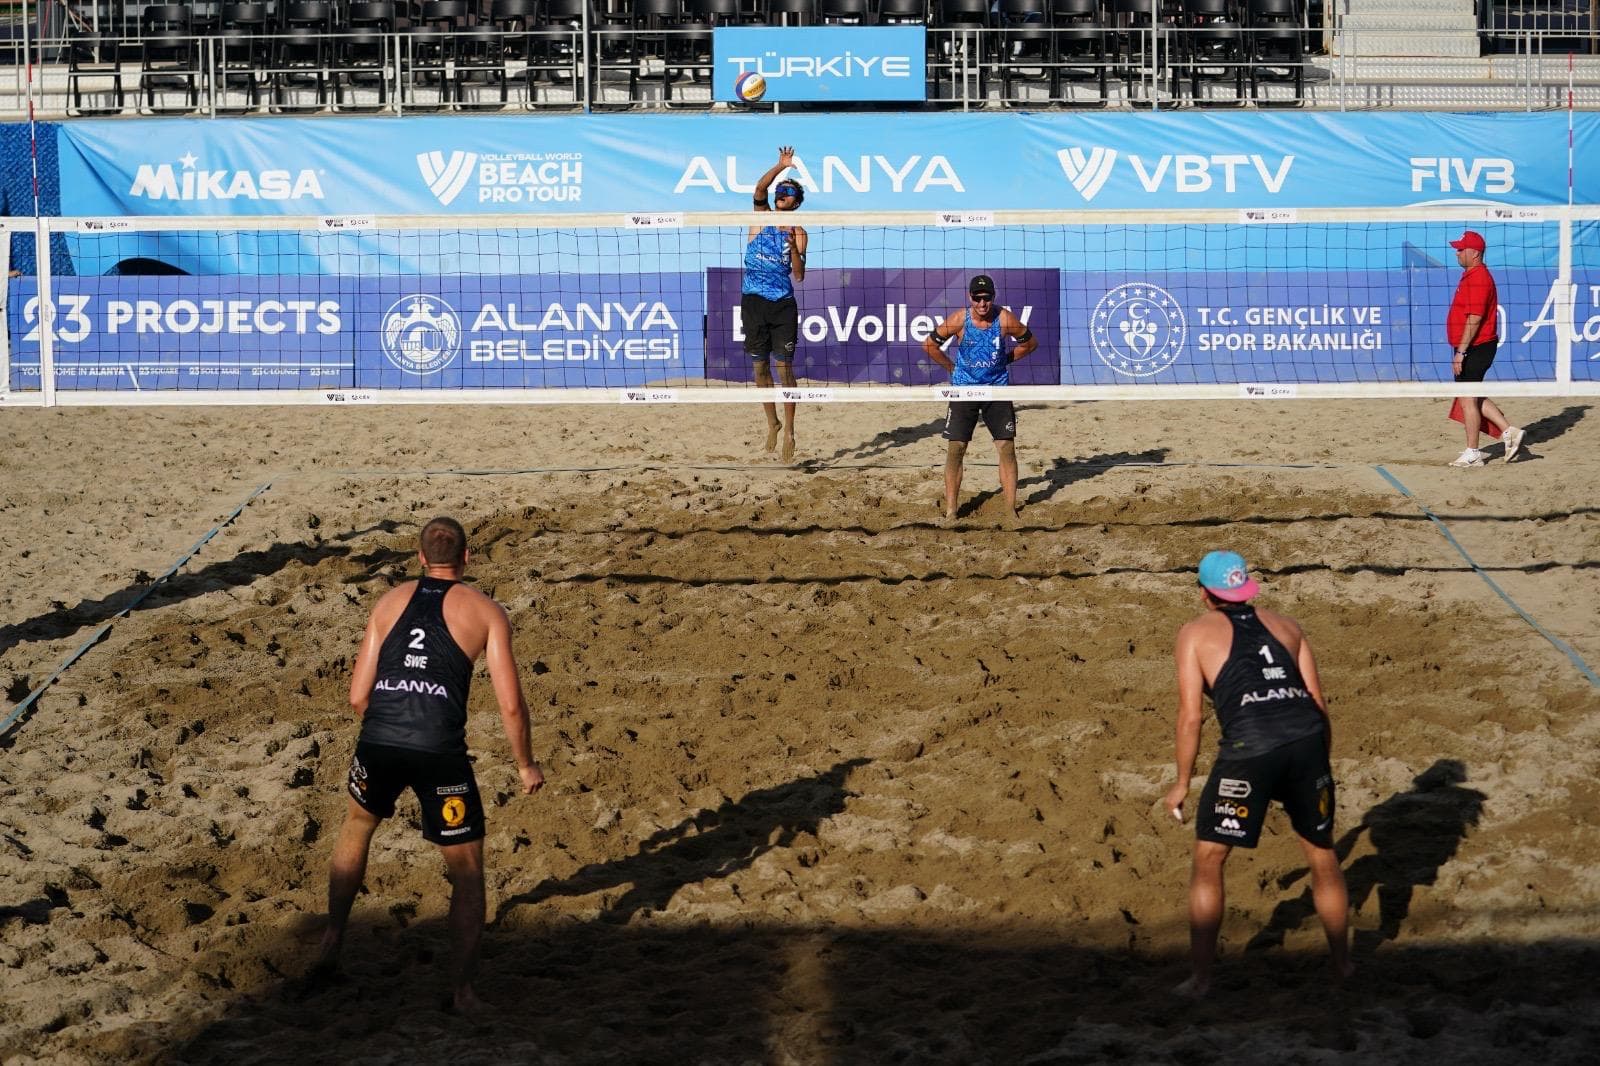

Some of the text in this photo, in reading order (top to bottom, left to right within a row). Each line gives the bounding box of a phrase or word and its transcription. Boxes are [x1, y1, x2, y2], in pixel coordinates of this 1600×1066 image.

[728, 51, 911, 77] TÜRKİYE
[480, 152, 583, 161] VOLLEYBALL WORLD
[479, 162, 583, 185] BEACH
[1128, 154, 1296, 193] VBTV
[479, 186, 582, 202] PRO TOUR
[107, 300, 341, 335] PROJECTS
[471, 302, 679, 333] ALANYA
[1198, 304, 1382, 329] T.C. GENÇLİK VE
[470, 333, 680, 362] BELEDİYESİ
[1198, 329, 1382, 351] SPOR BAKANLIĞI
[89, 368, 125, 376] ALANYA
[408, 628, 426, 650] 2
[403, 654, 428, 669] SWE
[1258, 645, 1274, 665] 1
[374, 679, 448, 699] ALANYA
